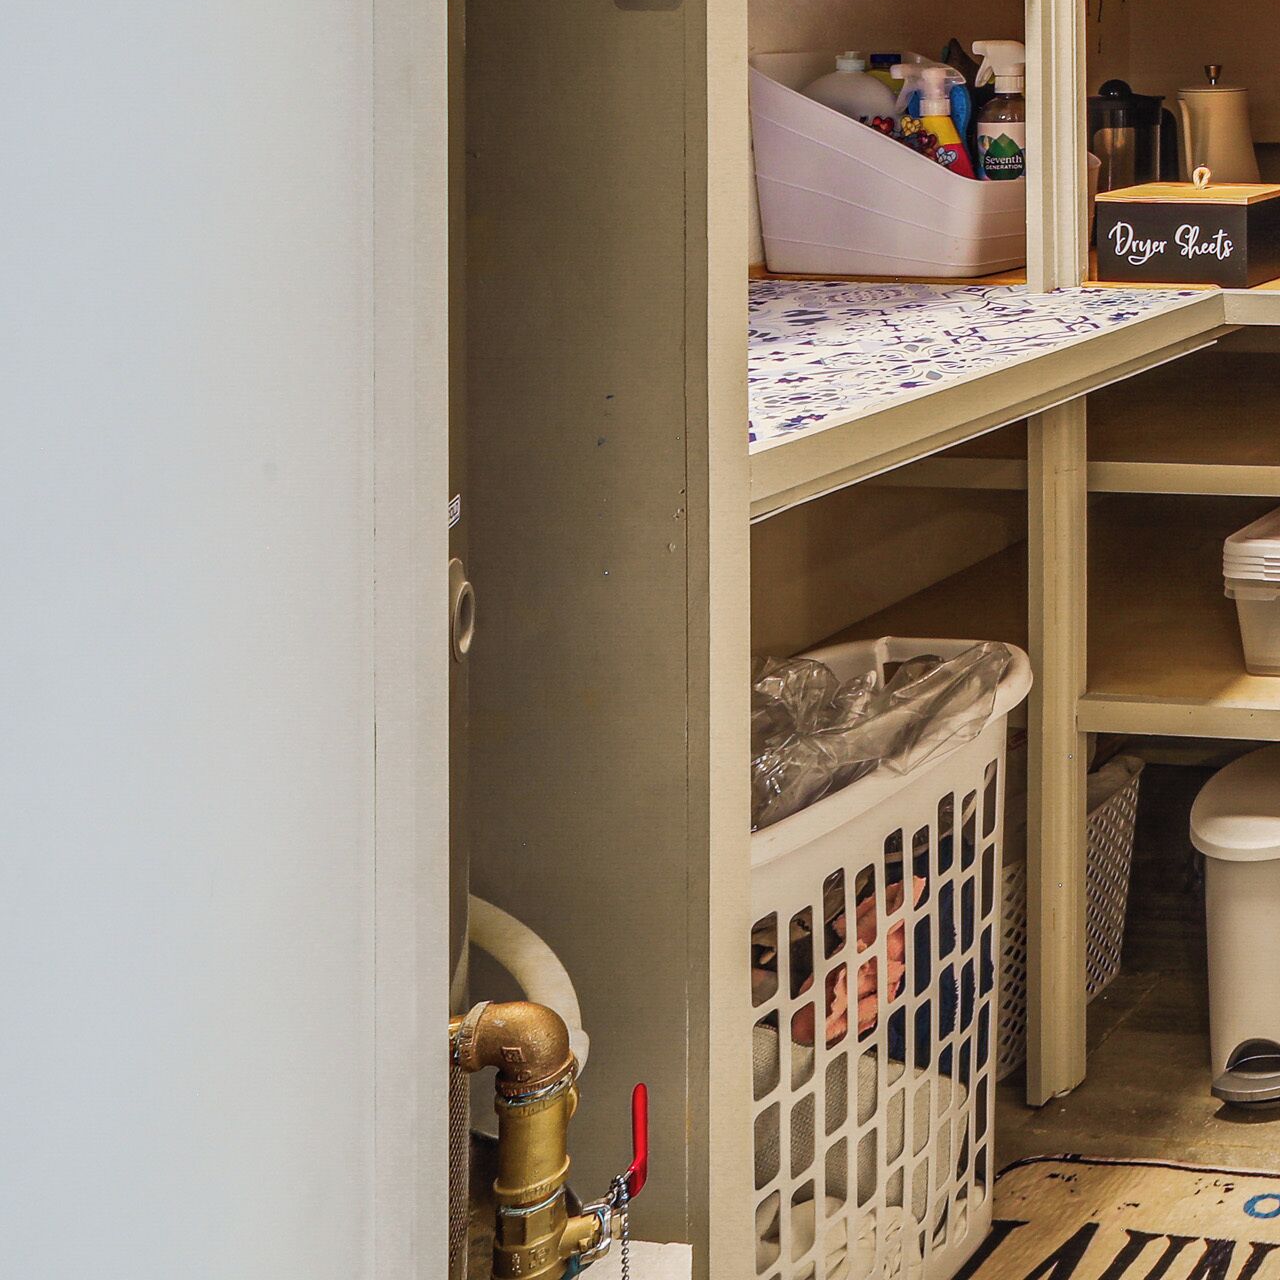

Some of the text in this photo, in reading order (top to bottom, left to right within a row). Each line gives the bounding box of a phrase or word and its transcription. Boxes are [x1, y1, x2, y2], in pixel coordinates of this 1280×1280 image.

[985, 155, 1022, 164] Seventh
[1108, 221, 1234, 266] Dryer Sheets
